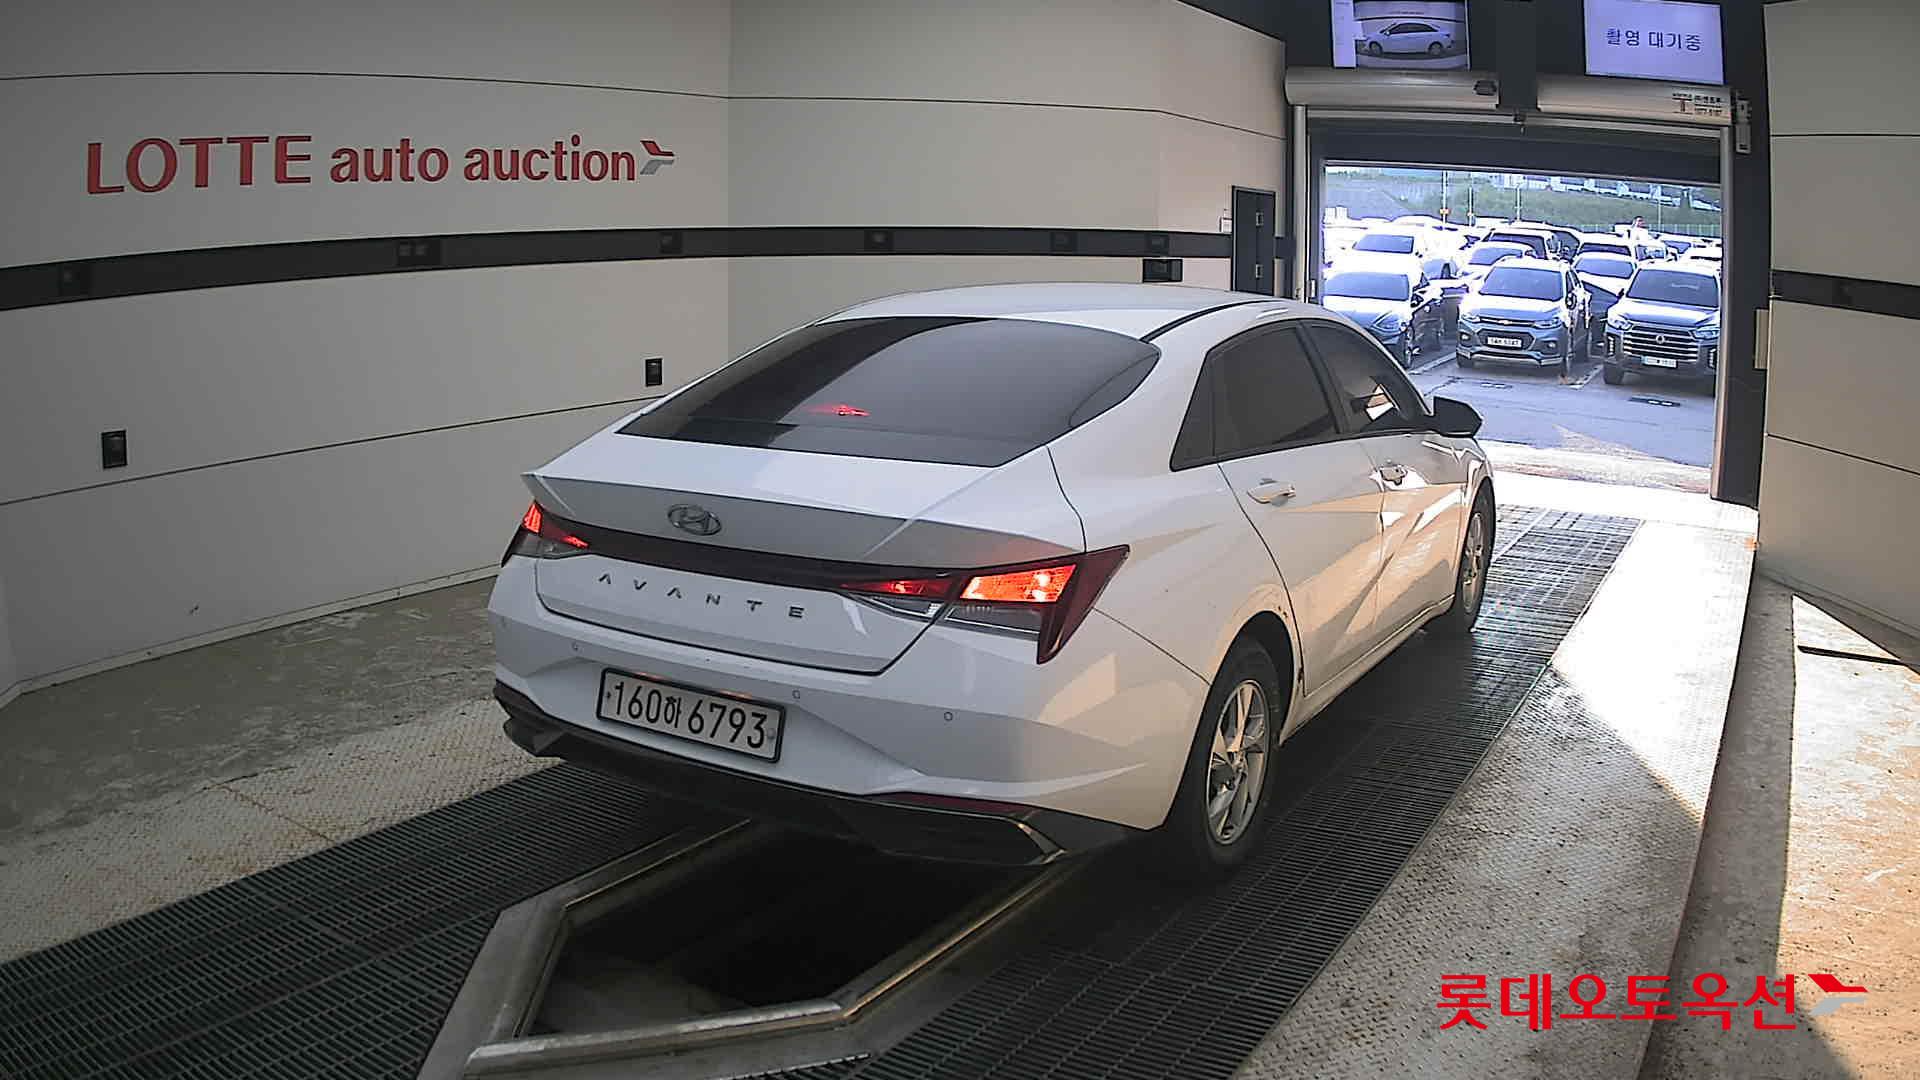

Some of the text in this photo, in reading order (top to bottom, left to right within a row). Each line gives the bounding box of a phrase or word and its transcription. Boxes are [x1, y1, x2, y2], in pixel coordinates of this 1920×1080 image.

[1648, 31, 1702, 52] 대기중
[87, 134, 637, 194] LOTTE auto auction
[598, 573, 805, 618] AVANTE
